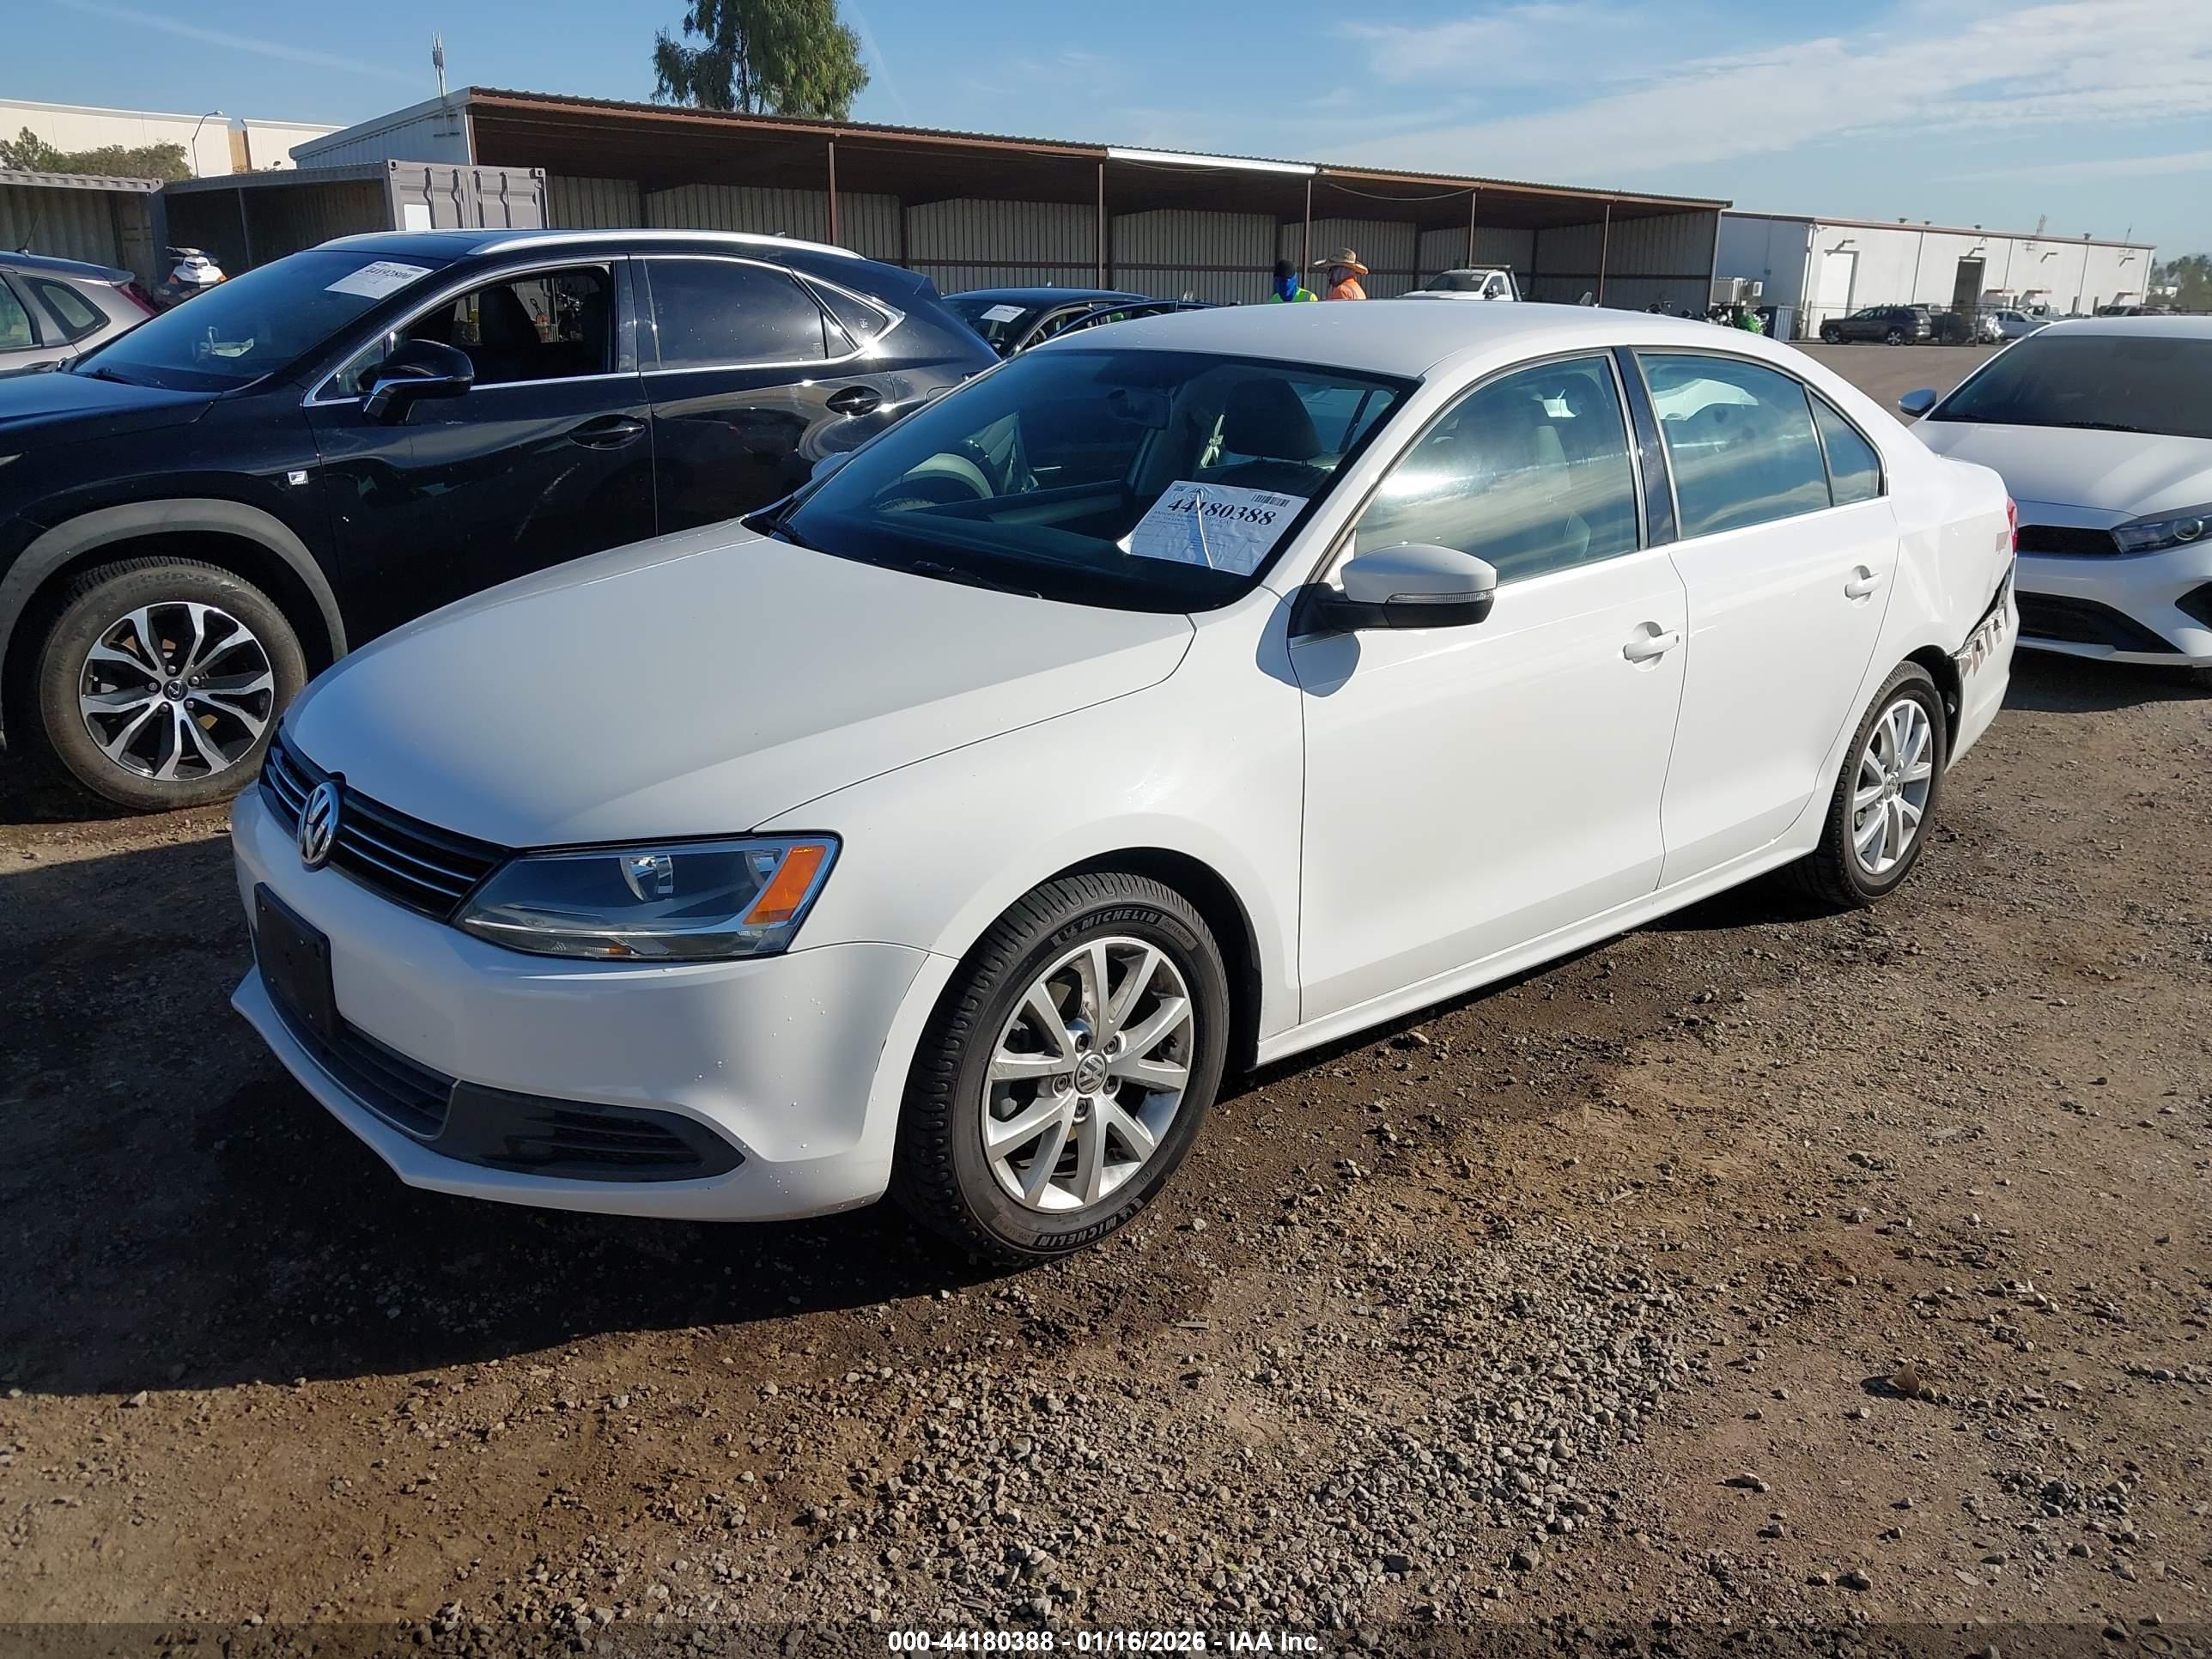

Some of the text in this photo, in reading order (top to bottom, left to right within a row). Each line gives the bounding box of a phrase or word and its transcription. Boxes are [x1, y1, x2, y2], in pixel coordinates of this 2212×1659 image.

[1167, 497, 1277, 526] 44180388
[1081, 909, 1158, 931] MICHELIN
[1036, 1215, 1117, 1246] MICHELIN
